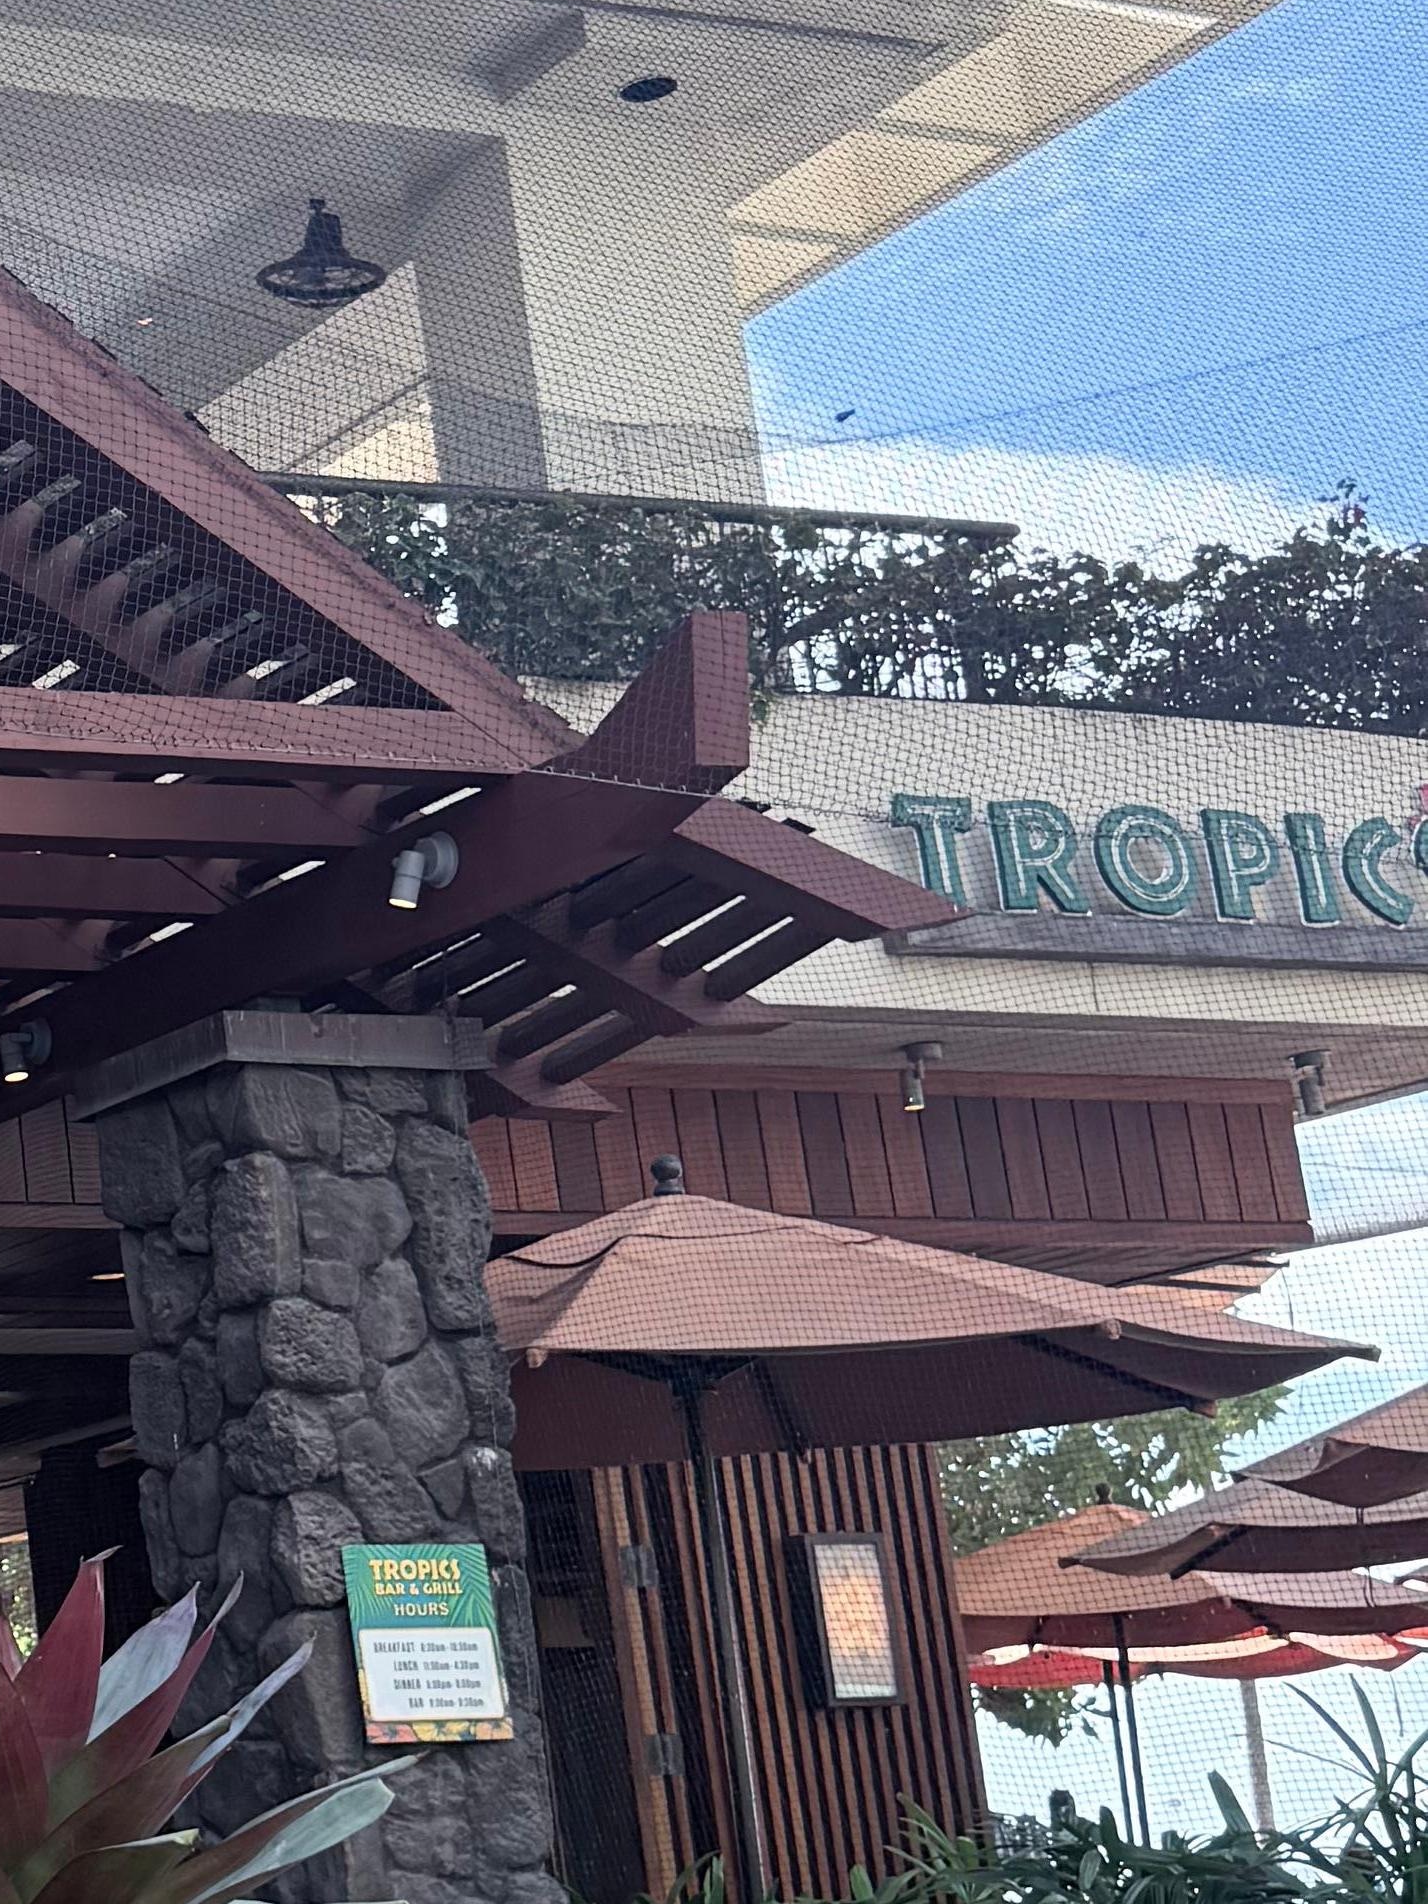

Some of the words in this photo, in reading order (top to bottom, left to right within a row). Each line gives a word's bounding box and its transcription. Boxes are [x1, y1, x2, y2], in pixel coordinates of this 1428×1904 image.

[369, 1558, 461, 1580] TROPICS
[375, 1582, 405, 1595] BAR
[409, 1583, 419, 1595] &
[423, 1581, 463, 1594] GRILL
[393, 1602, 449, 1616] HOURS
[373, 1642, 415, 1653] BREAKFAST
[393, 1660, 418, 1671] LUNCH
[393, 1678, 421, 1690] DINNER
[408, 1697, 424, 1708] BAR
